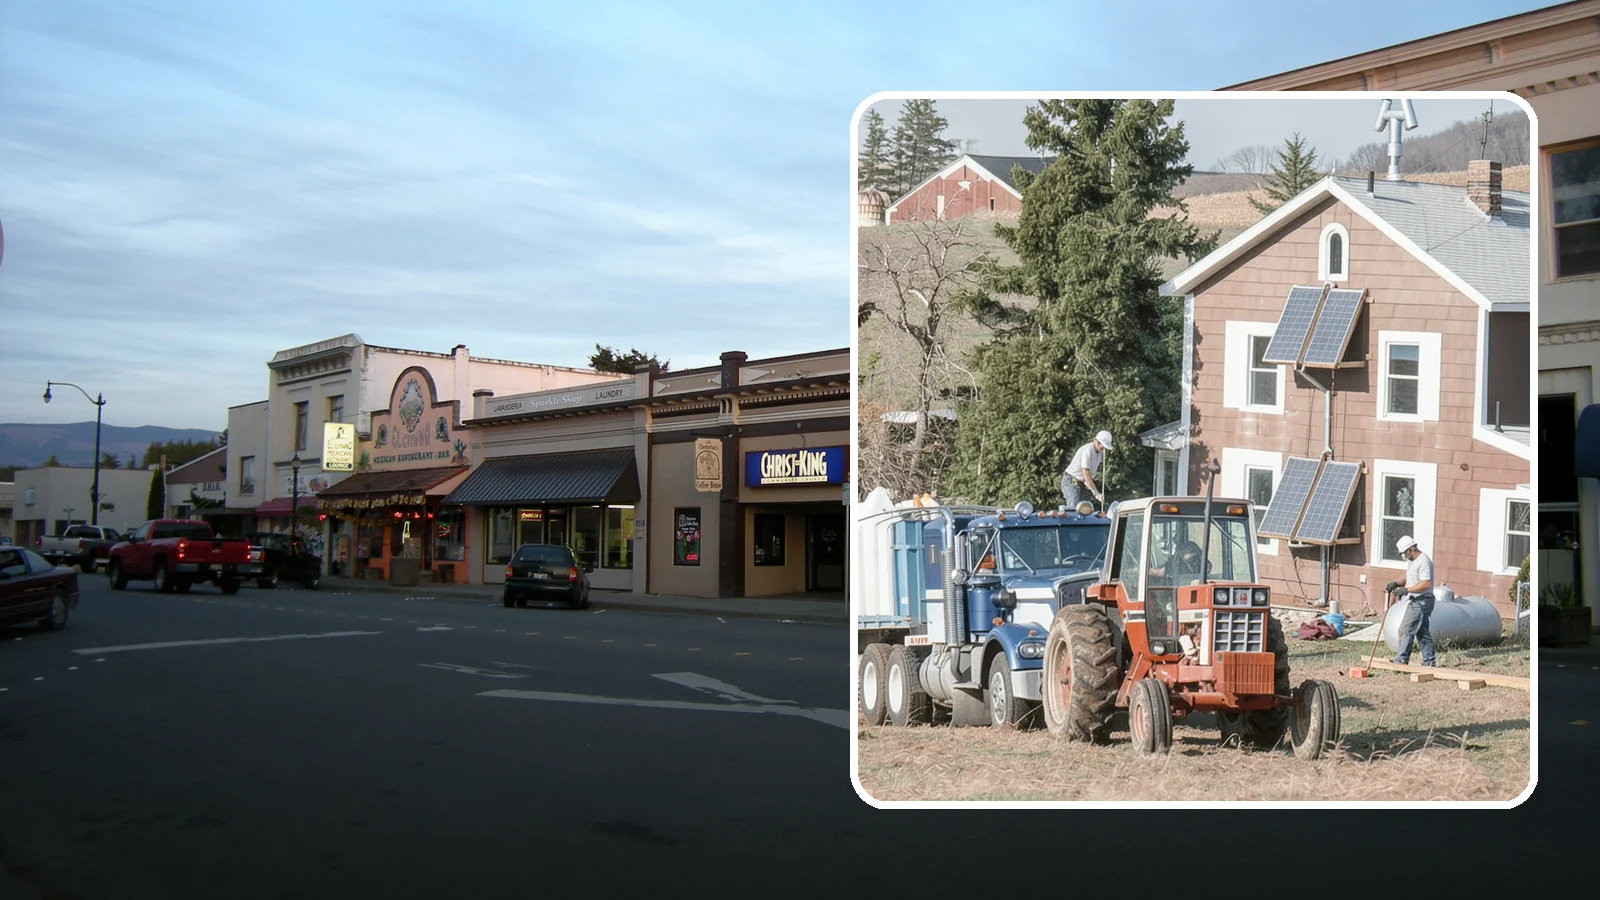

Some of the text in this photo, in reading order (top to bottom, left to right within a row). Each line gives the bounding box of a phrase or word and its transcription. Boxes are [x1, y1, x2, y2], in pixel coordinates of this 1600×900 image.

[531, 394, 583, 409] Sparkle Shop
[595, 389, 623, 400] LAUNDRY
[493, 402, 522, 412] LAVANDERIA
[373, 454, 396, 464] MEXICAN
[398, 451, 434, 463] RESTAURANT
[438, 450, 450, 459] BAR
[761, 450, 827, 478] CHRIST KING
